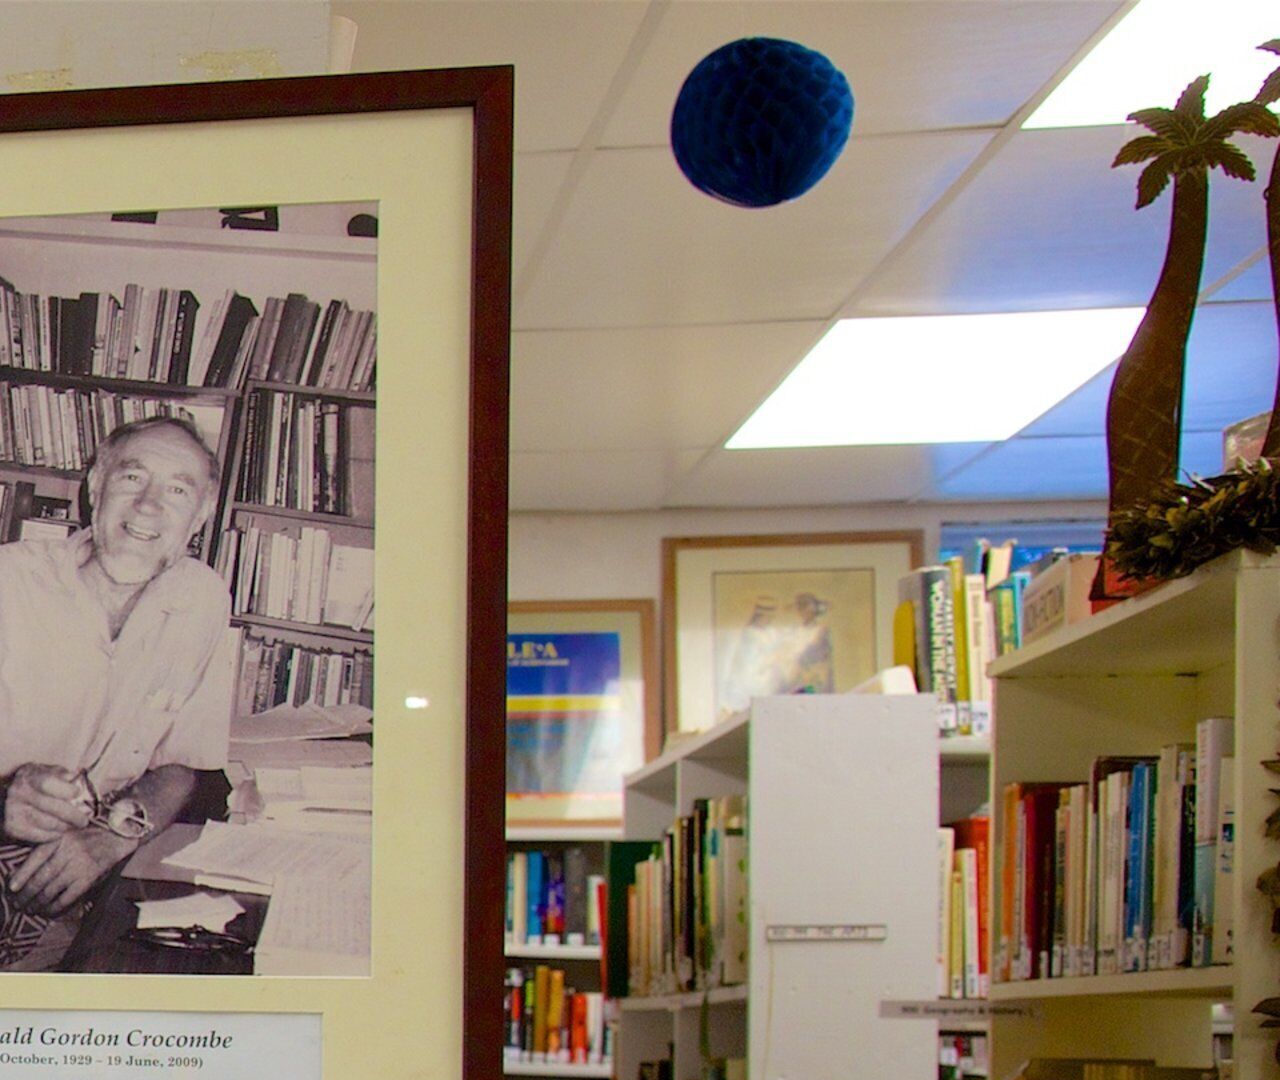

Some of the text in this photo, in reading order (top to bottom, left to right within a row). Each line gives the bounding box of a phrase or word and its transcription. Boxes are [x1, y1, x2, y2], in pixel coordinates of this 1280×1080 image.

[39, 1027, 118, 1046] Gordon
[126, 1029, 232, 1048] Crocombe
[0, 1052, 57, 1065] October,
[63, 1054, 92, 1065] 1929
[107, 1055, 121, 1065] 19
[125, 1055, 163, 1067] June,
[167, 1056, 202, 1068] 2009)
